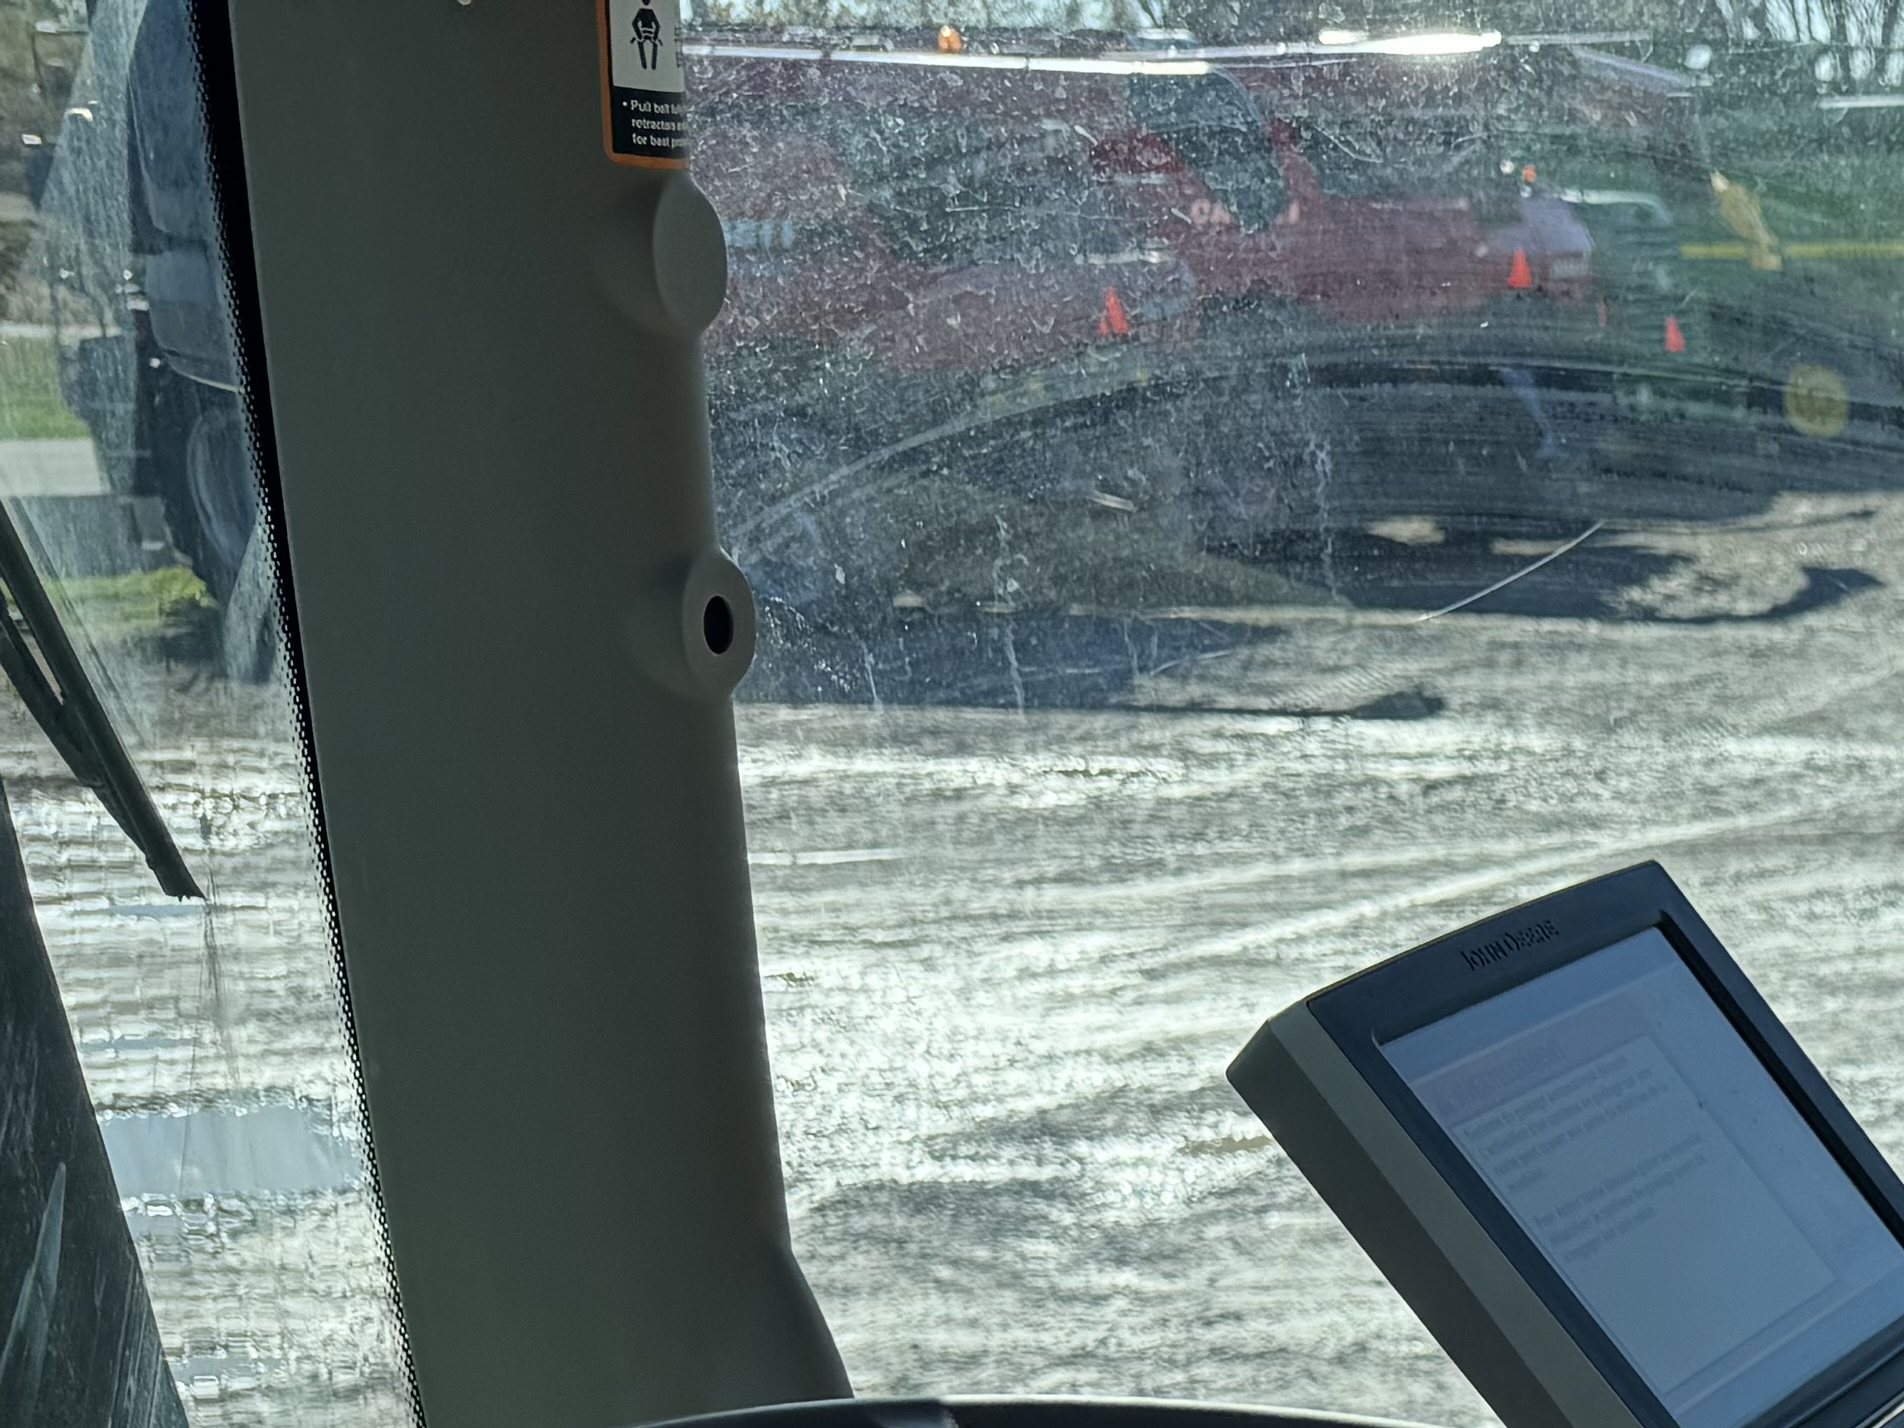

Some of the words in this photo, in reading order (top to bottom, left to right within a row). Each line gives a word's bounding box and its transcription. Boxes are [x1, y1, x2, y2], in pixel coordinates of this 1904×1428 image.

[630, 99, 652, 112] Pull
[632, 133, 648, 145] for
[1460, 940, 1508, 971] JOHN
